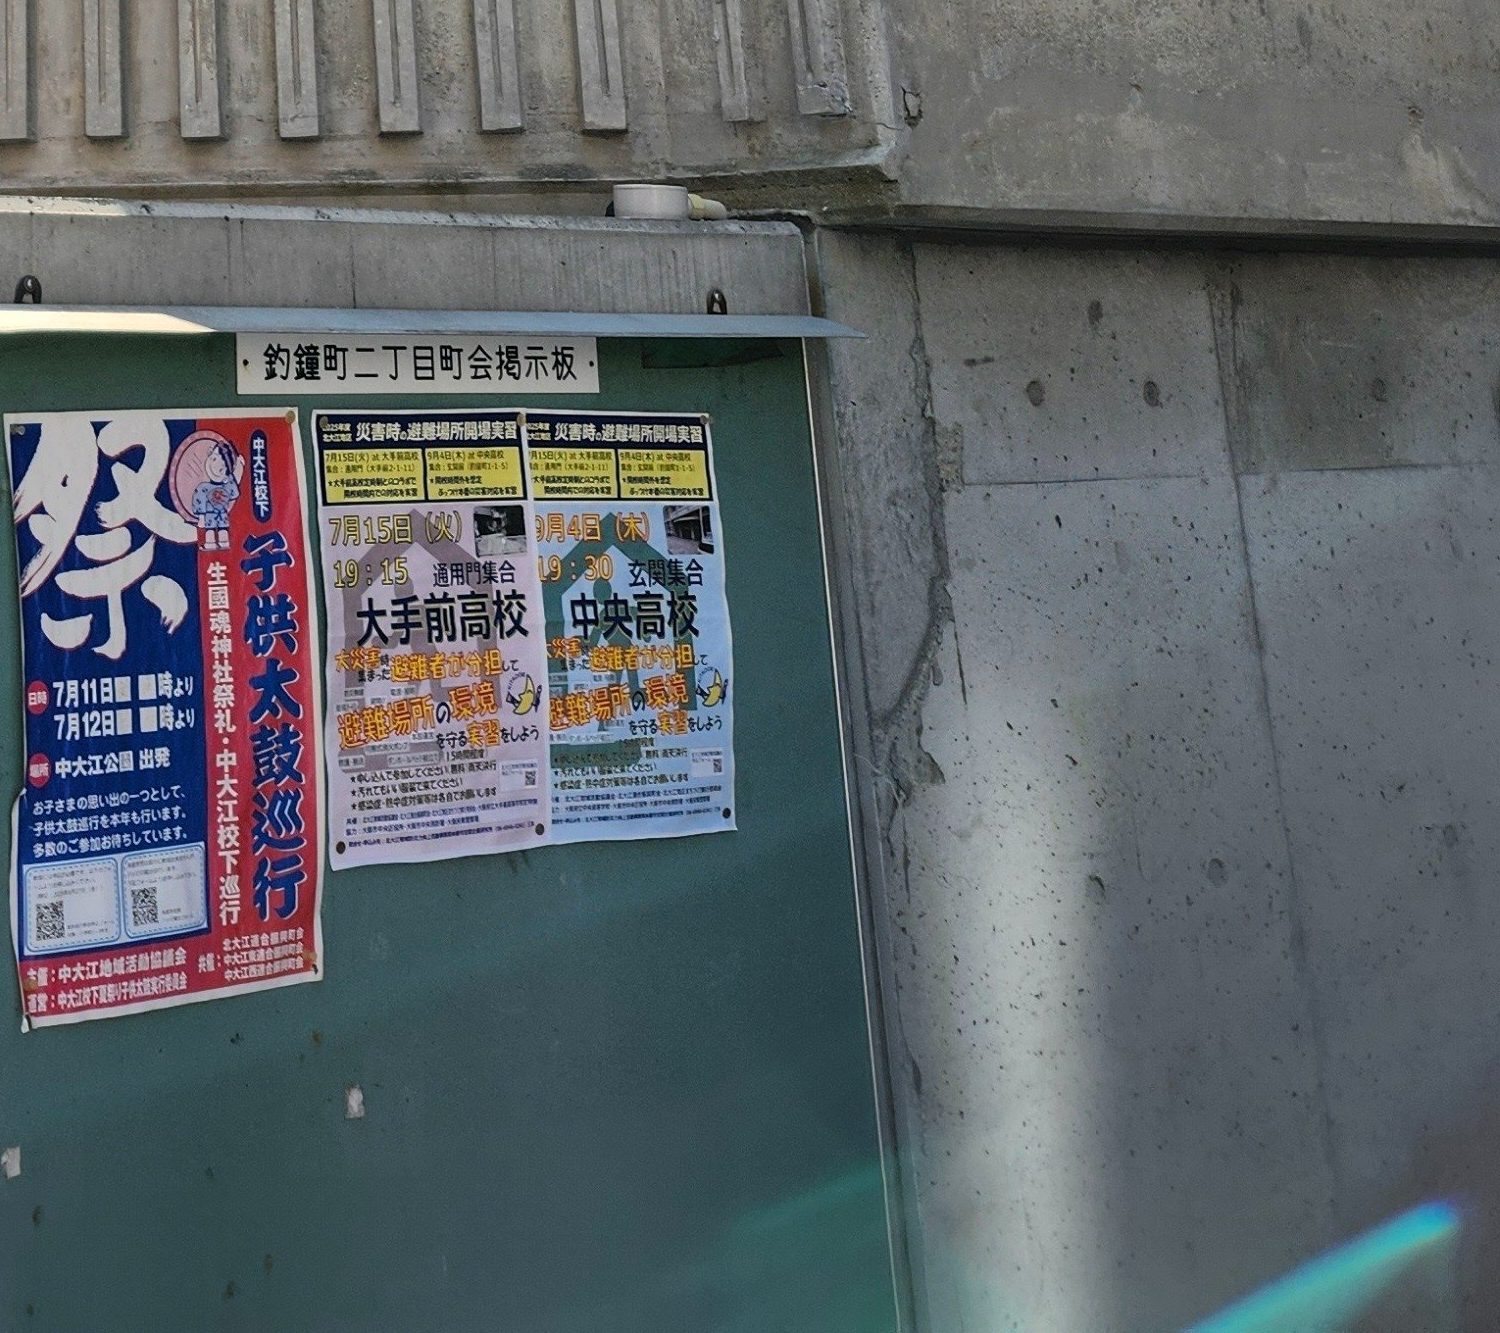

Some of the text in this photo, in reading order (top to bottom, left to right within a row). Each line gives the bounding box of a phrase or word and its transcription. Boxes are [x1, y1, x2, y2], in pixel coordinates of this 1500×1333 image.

[263, 342, 578, 382] 釣鐘町二丁目町会掲示板
[355, 420, 518, 442] 災害時の避難場所開場実習
[554, 422, 703, 444] 災害時の避難場所開場実習
[251, 436, 270, 518] 中大江校下
[13, 420, 199, 660] 祭
[433, 560, 516, 588] 通用門集合
[628, 559, 704, 587] 玄関集合
[356, 589, 529, 646] 大手前高校
[570, 591, 700, 641] 中央高校
[27, 691, 48, 706] 日時
[205, 561, 241, 926] 生國魂神社祭礼・中大江校下巡行
[240, 530, 308, 923] 子供太鼓巡行
[55, 747, 171, 779] 中大江公園 出発
